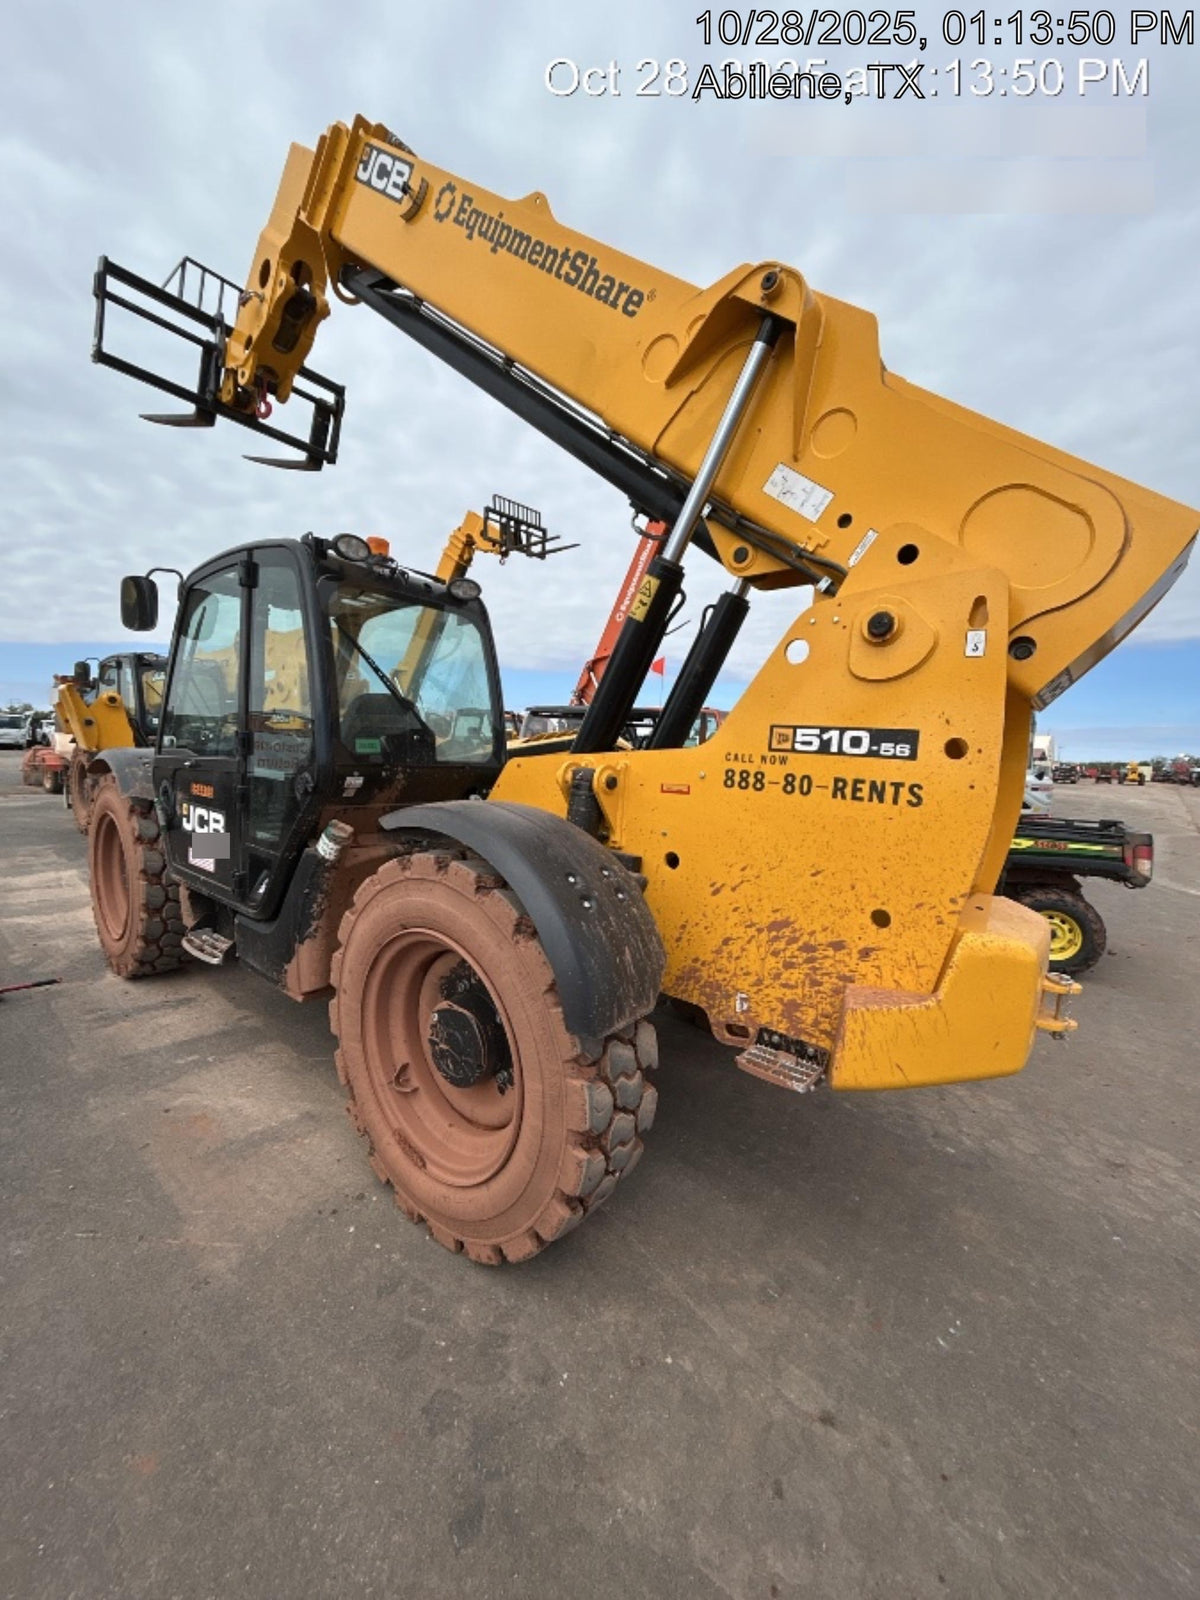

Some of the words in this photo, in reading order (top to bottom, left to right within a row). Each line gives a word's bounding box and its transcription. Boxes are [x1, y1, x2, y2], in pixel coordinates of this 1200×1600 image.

[356, 149, 411, 199] JCB
[724, 752, 755, 764] CALL
[760, 755, 789, 766] NOW
[723, 768, 924, 808] 888-80-RENTS
[182, 804, 226, 833] JCB
